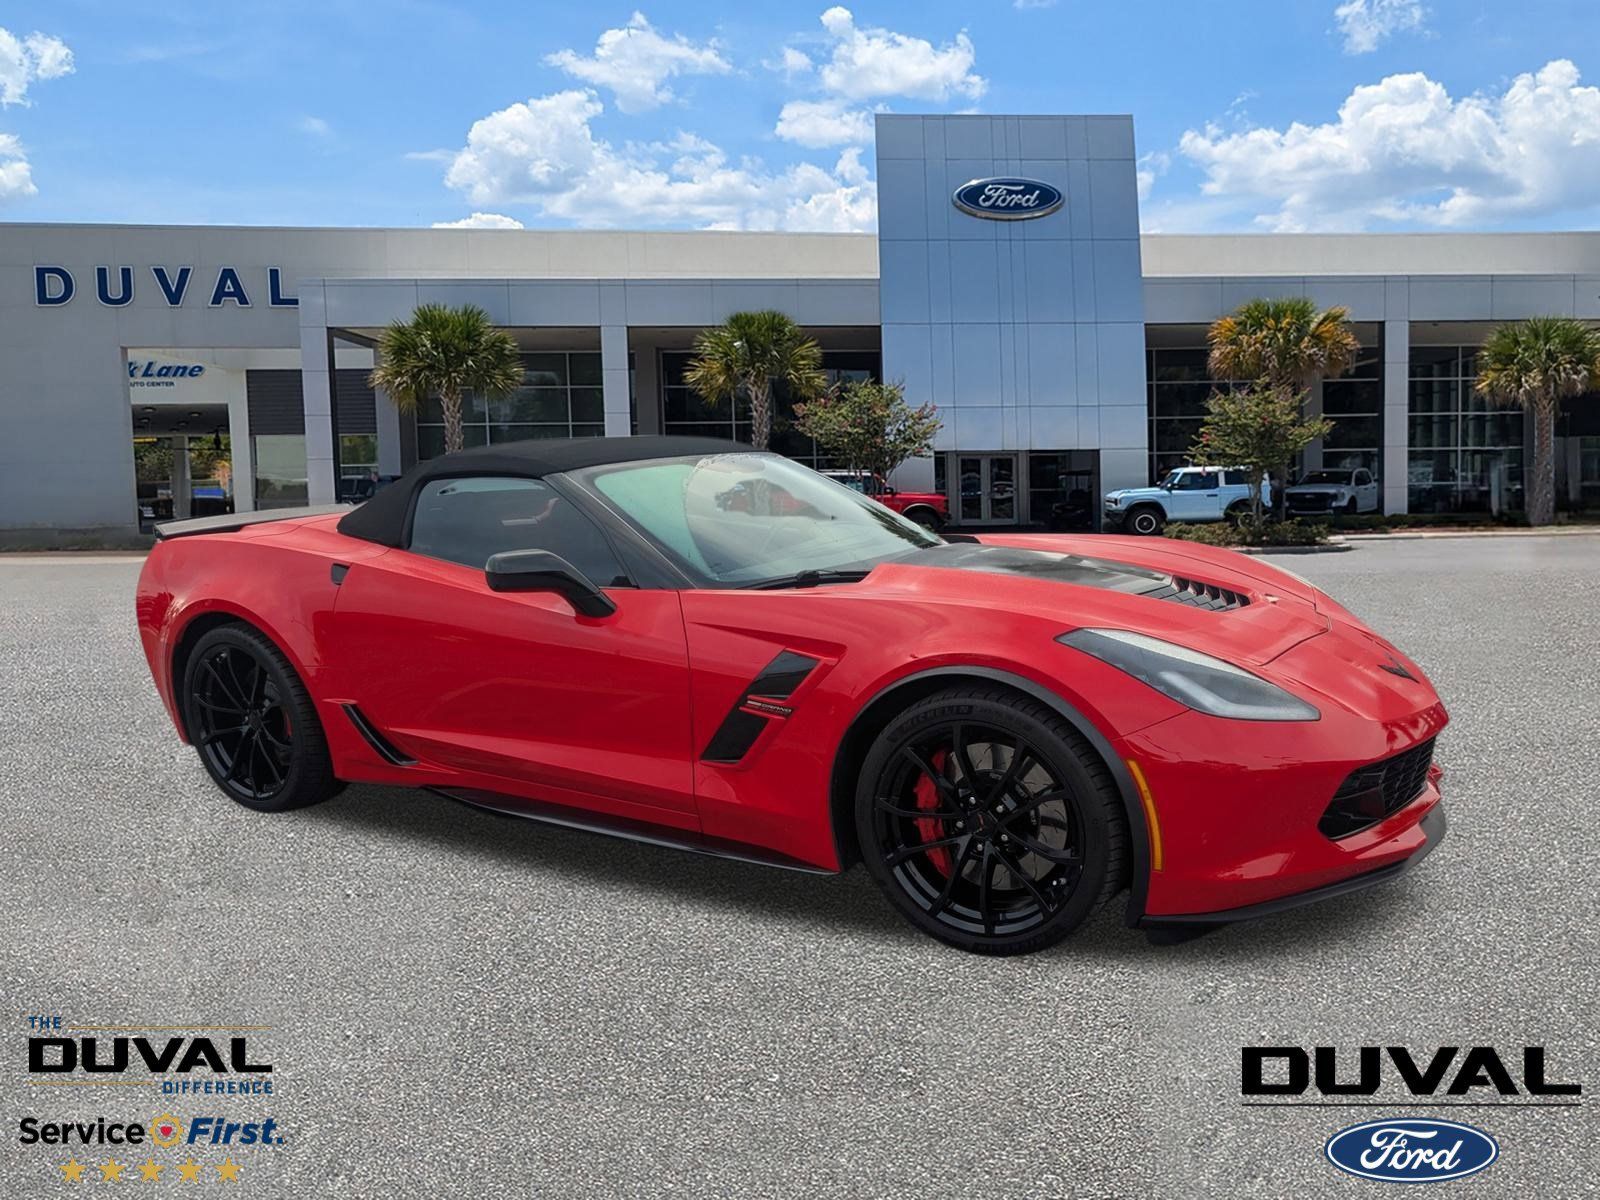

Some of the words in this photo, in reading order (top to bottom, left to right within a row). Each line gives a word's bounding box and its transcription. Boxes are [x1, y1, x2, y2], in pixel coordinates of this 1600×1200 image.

[978, 184, 1040, 207] Ford
[33, 265, 299, 308] DUVAL
[142, 361, 204, 378] Lane
